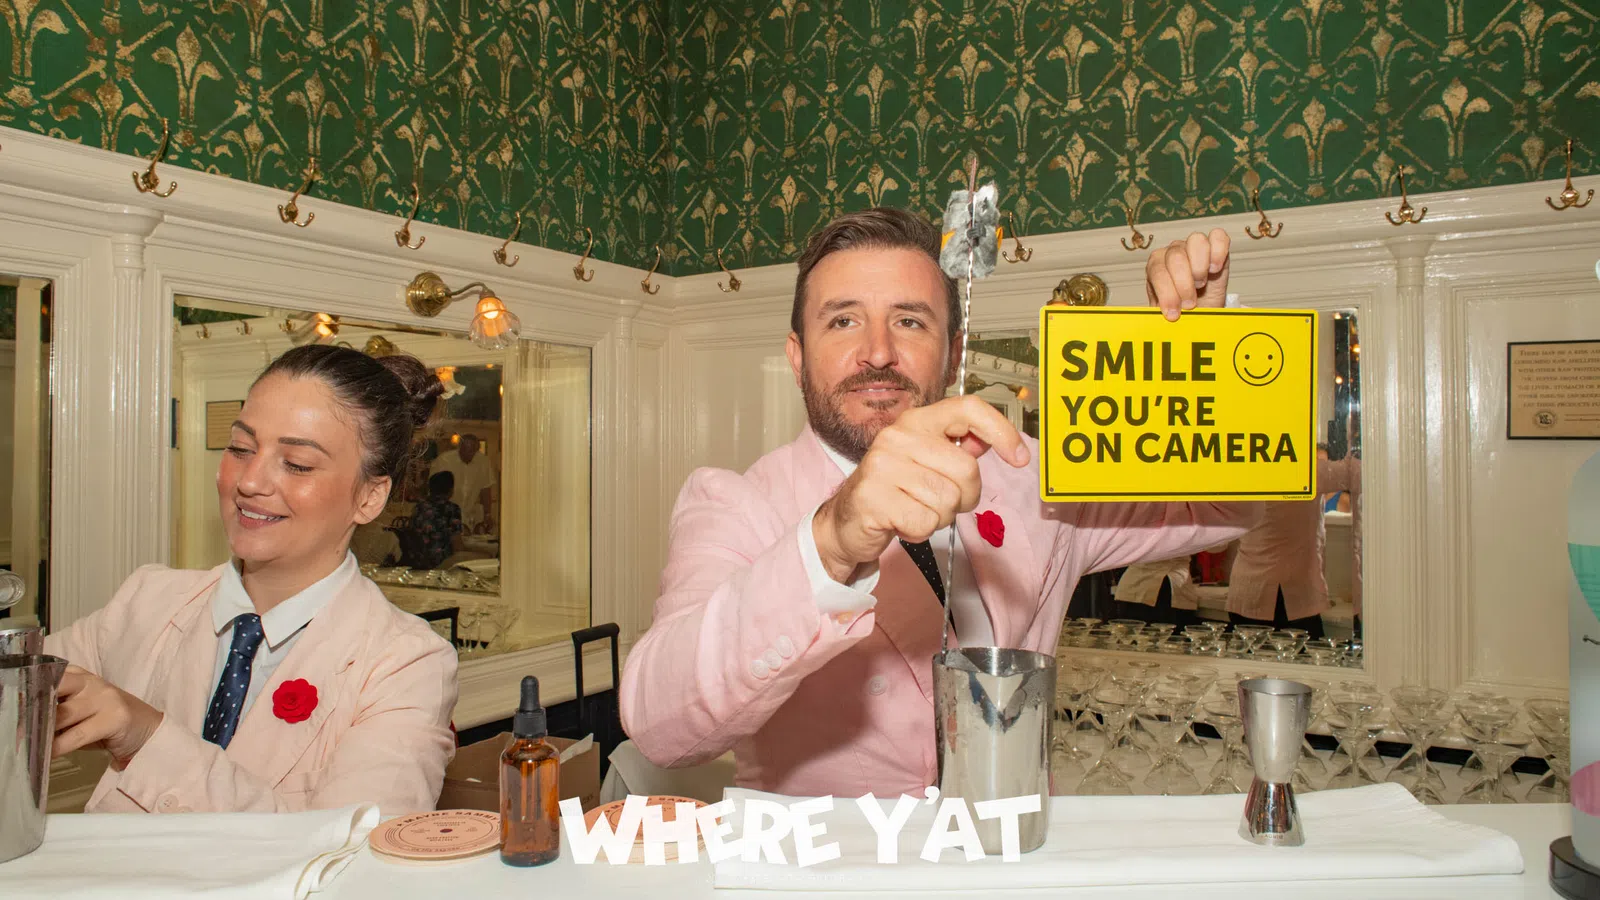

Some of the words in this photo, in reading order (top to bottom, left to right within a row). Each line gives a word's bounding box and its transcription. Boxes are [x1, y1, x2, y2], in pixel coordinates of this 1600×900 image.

[1062, 340, 1216, 382] SMILE
[1062, 395, 1216, 427] YOU'RE
[1062, 432, 1122, 463] ON
[1134, 432, 1298, 464] CAMERA
[455, 811, 498, 821] SAMMY
